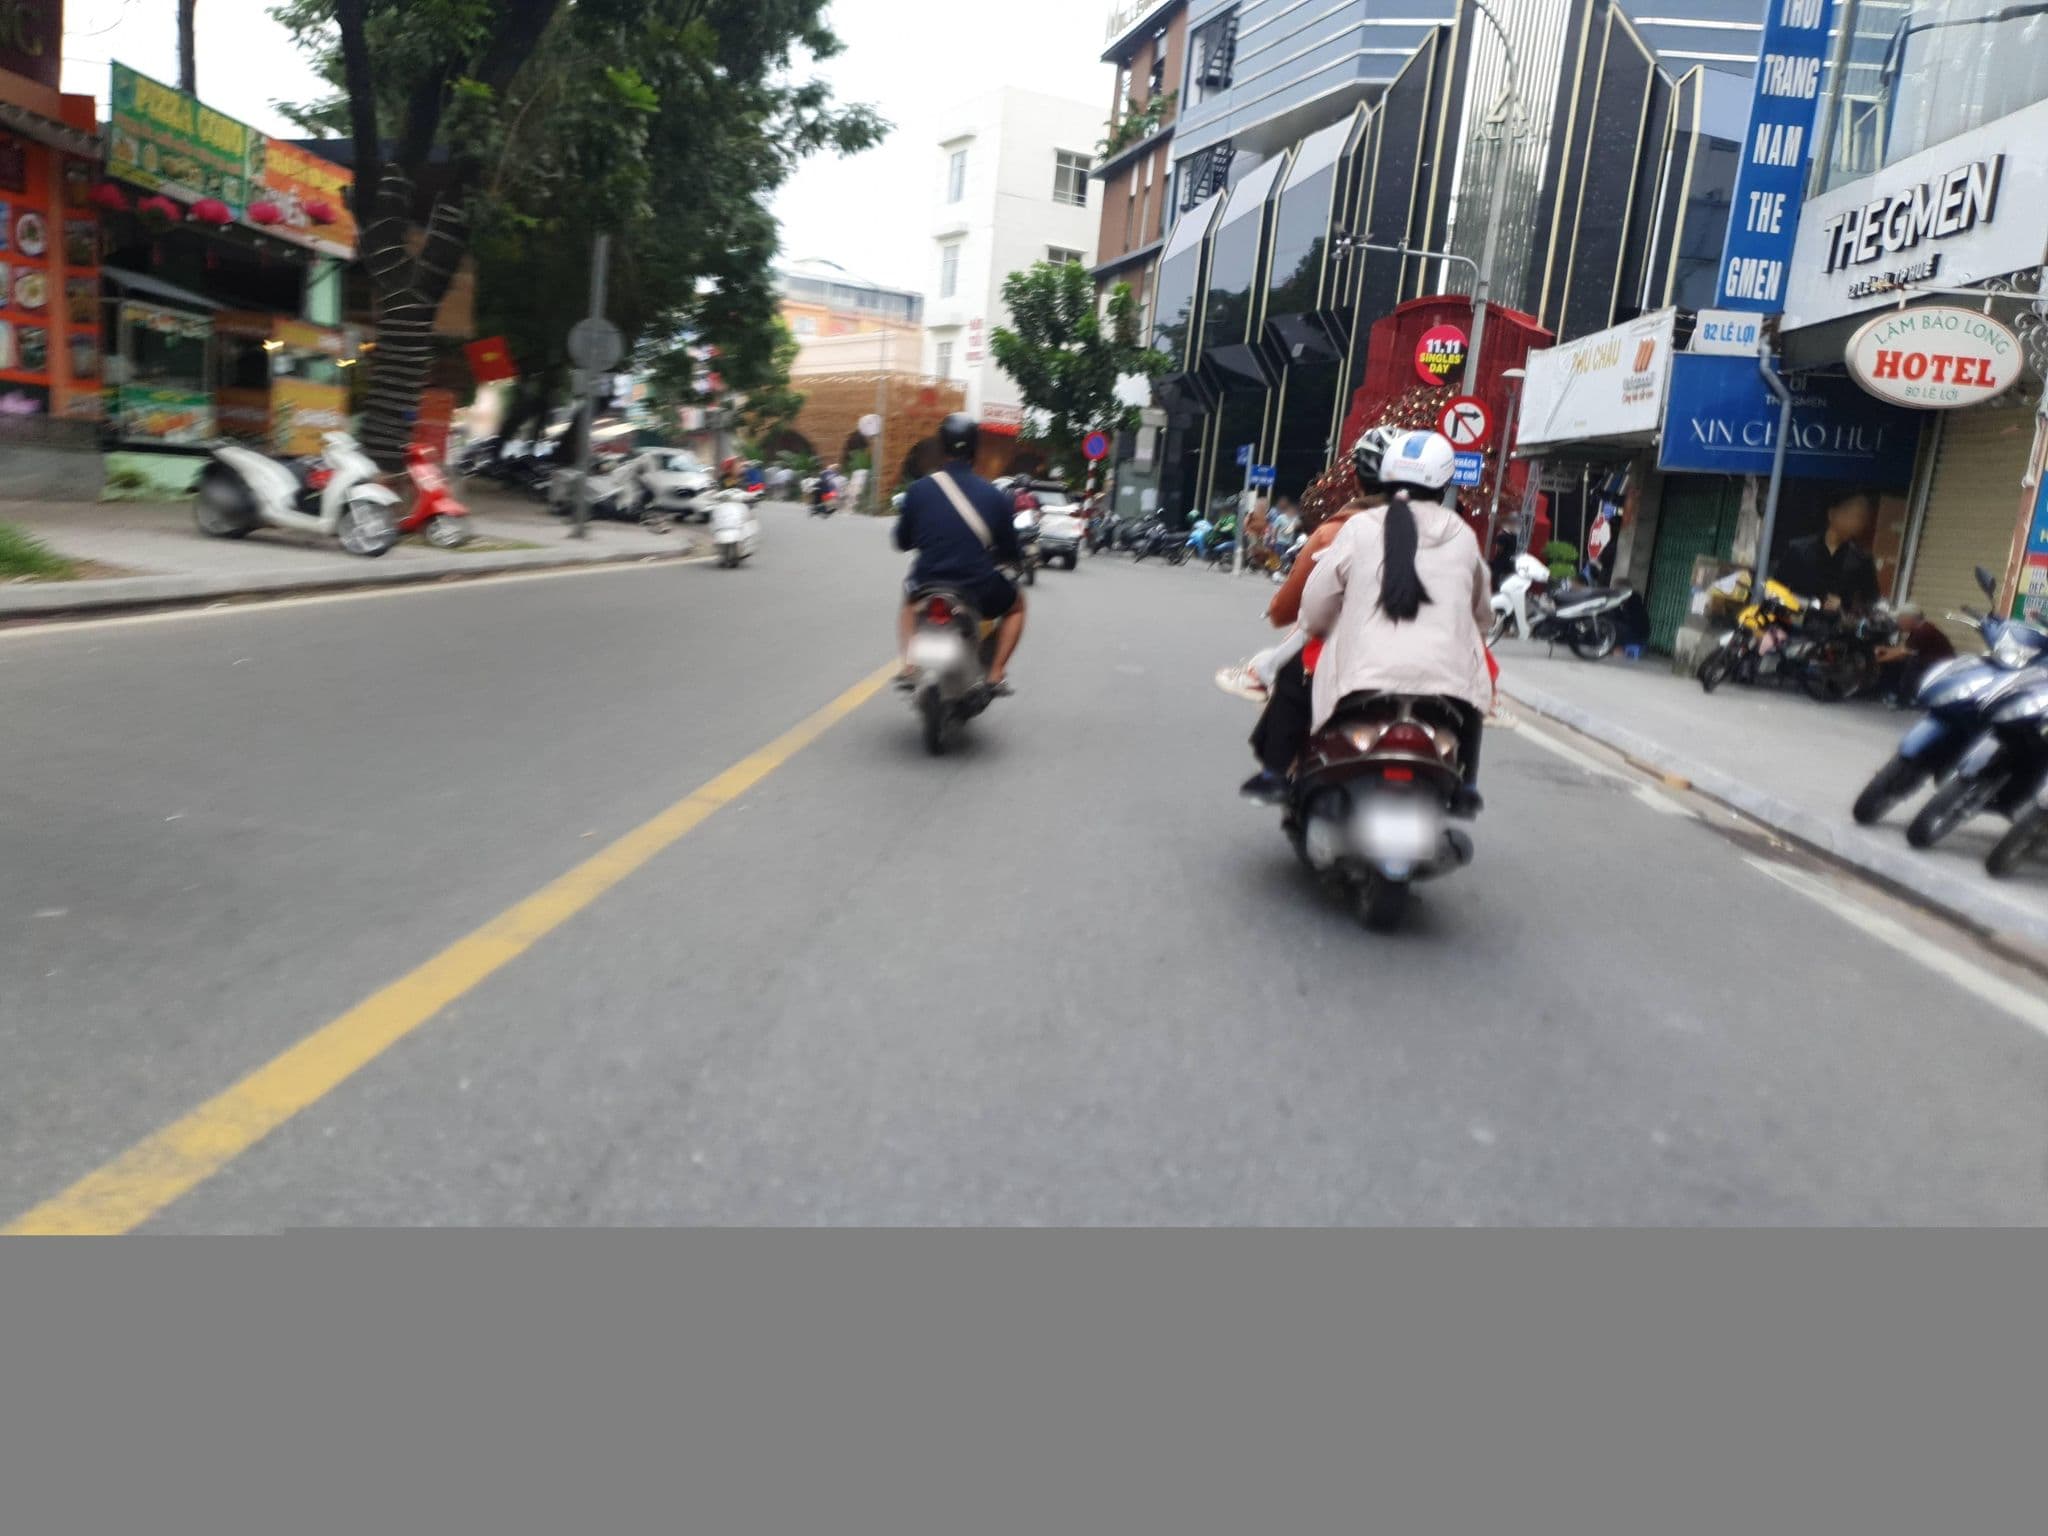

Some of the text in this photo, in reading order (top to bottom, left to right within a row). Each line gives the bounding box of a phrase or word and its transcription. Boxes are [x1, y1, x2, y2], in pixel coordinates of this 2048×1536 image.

[1761, 54, 1820, 99] TRANG
[1752, 123, 1803, 167] NAM
[1746, 191, 1785, 234] THE
[1725, 257, 1783, 301] GMEN
[1427, 339, 1460, 354] 11.11
[1704, 323, 1718, 340] 82
[1964, 319, 2011, 355] LONG
[1429, 363, 1449, 374] DAY
[1872, 349, 1996, 388] HOTEL
[1690, 418, 1734, 444] XIN
